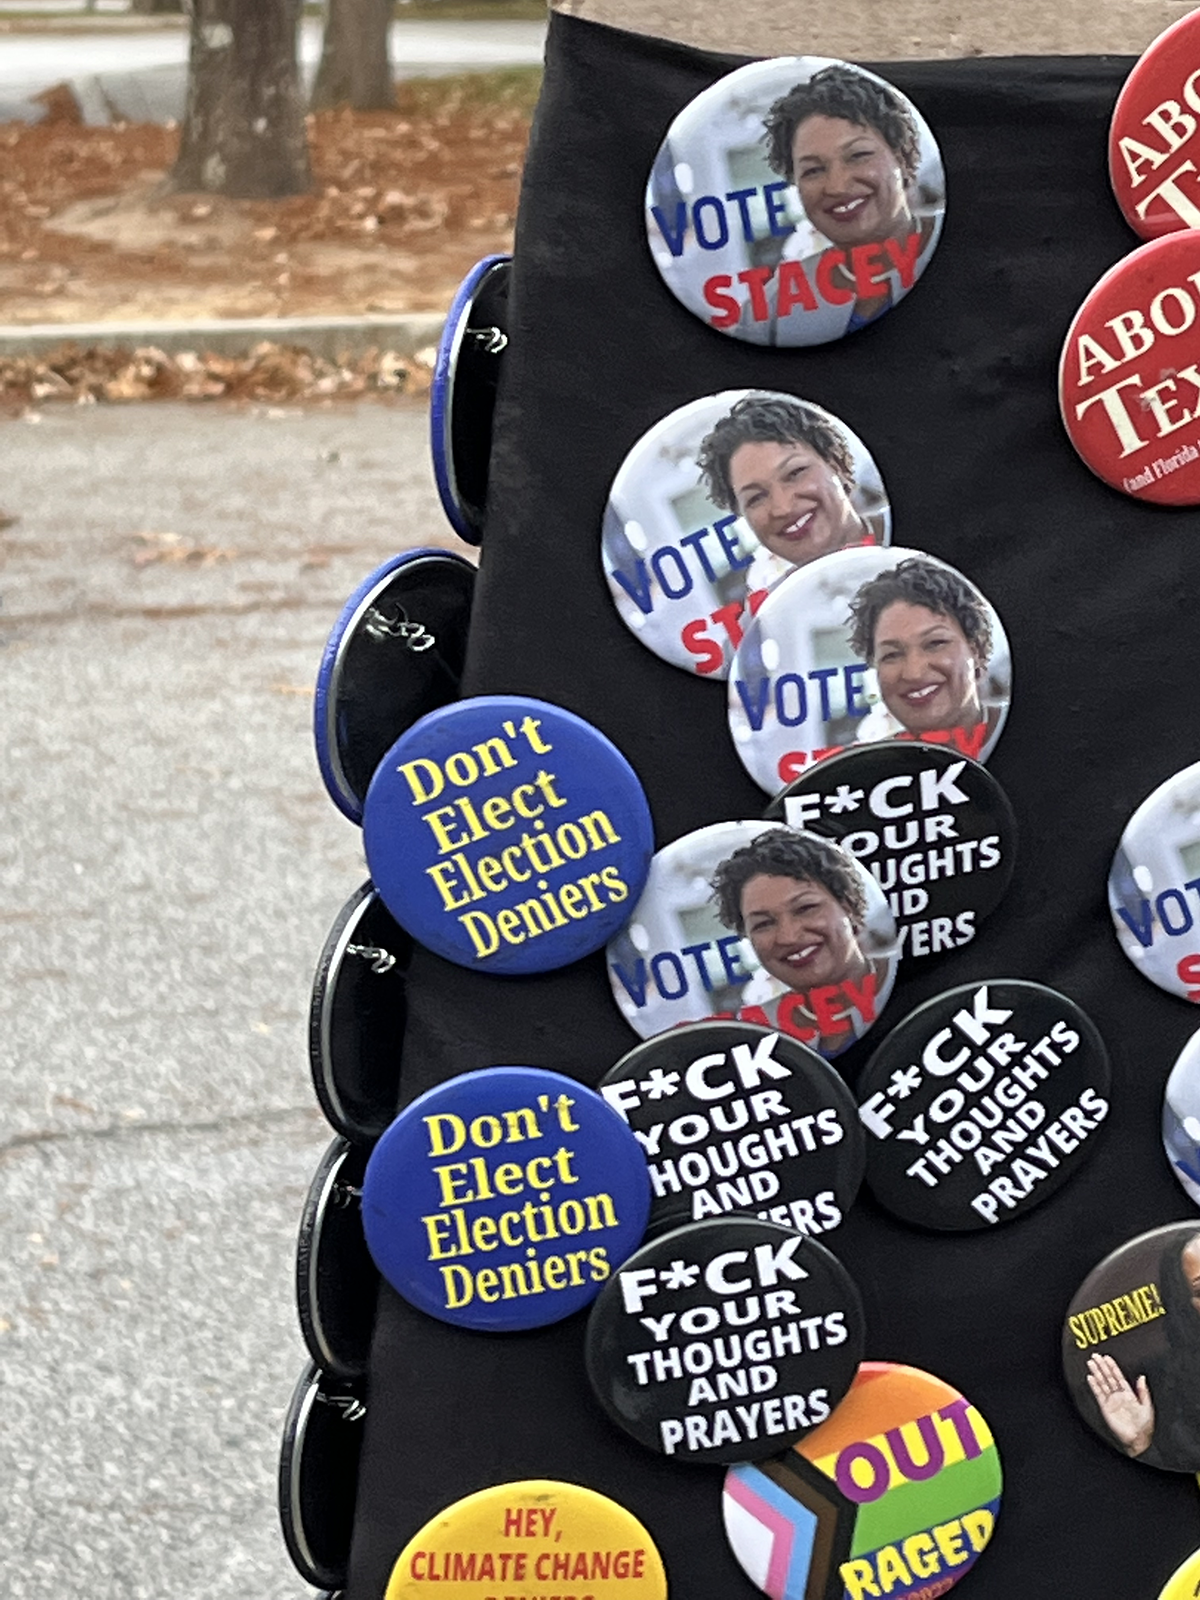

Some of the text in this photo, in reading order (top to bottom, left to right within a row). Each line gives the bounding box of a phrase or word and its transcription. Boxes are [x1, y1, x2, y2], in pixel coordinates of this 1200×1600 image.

[651, 182, 796, 257] VOTE
[703, 233, 921, 328] STACEY
[1077, 270, 1200, 387] ABO
[1152, 445, 1199, 478] Florida
[612, 514, 755, 615] VOTE
[735, 663, 873, 732] VOTE
[397, 716, 552, 806] Don't
[421, 770, 567, 855] Elect
[832, 815, 959, 858] OUR
[425, 810, 622, 911] Election
[870, 836, 1001, 891] UGHTS
[458, 866, 629, 958] Deniers
[612, 936, 753, 1008] VOTE
[634, 1090, 791, 1155] YOUR
[896, 1033, 1028, 1145] YOUR
[906, 1021, 1080, 1187] THOUGHTS
[422, 1094, 580, 1157] Don't
[648, 1109, 844, 1197] HOUGHTS
[971, 1088, 1109, 1224] PRAYERS
[973, 1100, 1046, 1176] AND
[433, 1147, 579, 1207] Elect
[692, 1170, 779, 1220] AND
[421, 1192, 619, 1260] Election
[439, 1247, 611, 1309] Deniers
[627, 1312, 848, 1385] THOUGHTS
[640, 1290, 801, 1342] YOUR
[1068, 1283, 1167, 1349] SUPREME!
[660, 1388, 831, 1455] PRAYERS
[688, 1365, 778, 1406] AND
[834, 1397, 983, 1505] OUT
[503, 1508, 563, 1543] HEY,
[839, 1509, 995, 1600] RAGED
[410, 1549, 646, 1582] CLIMATE CHANGE
